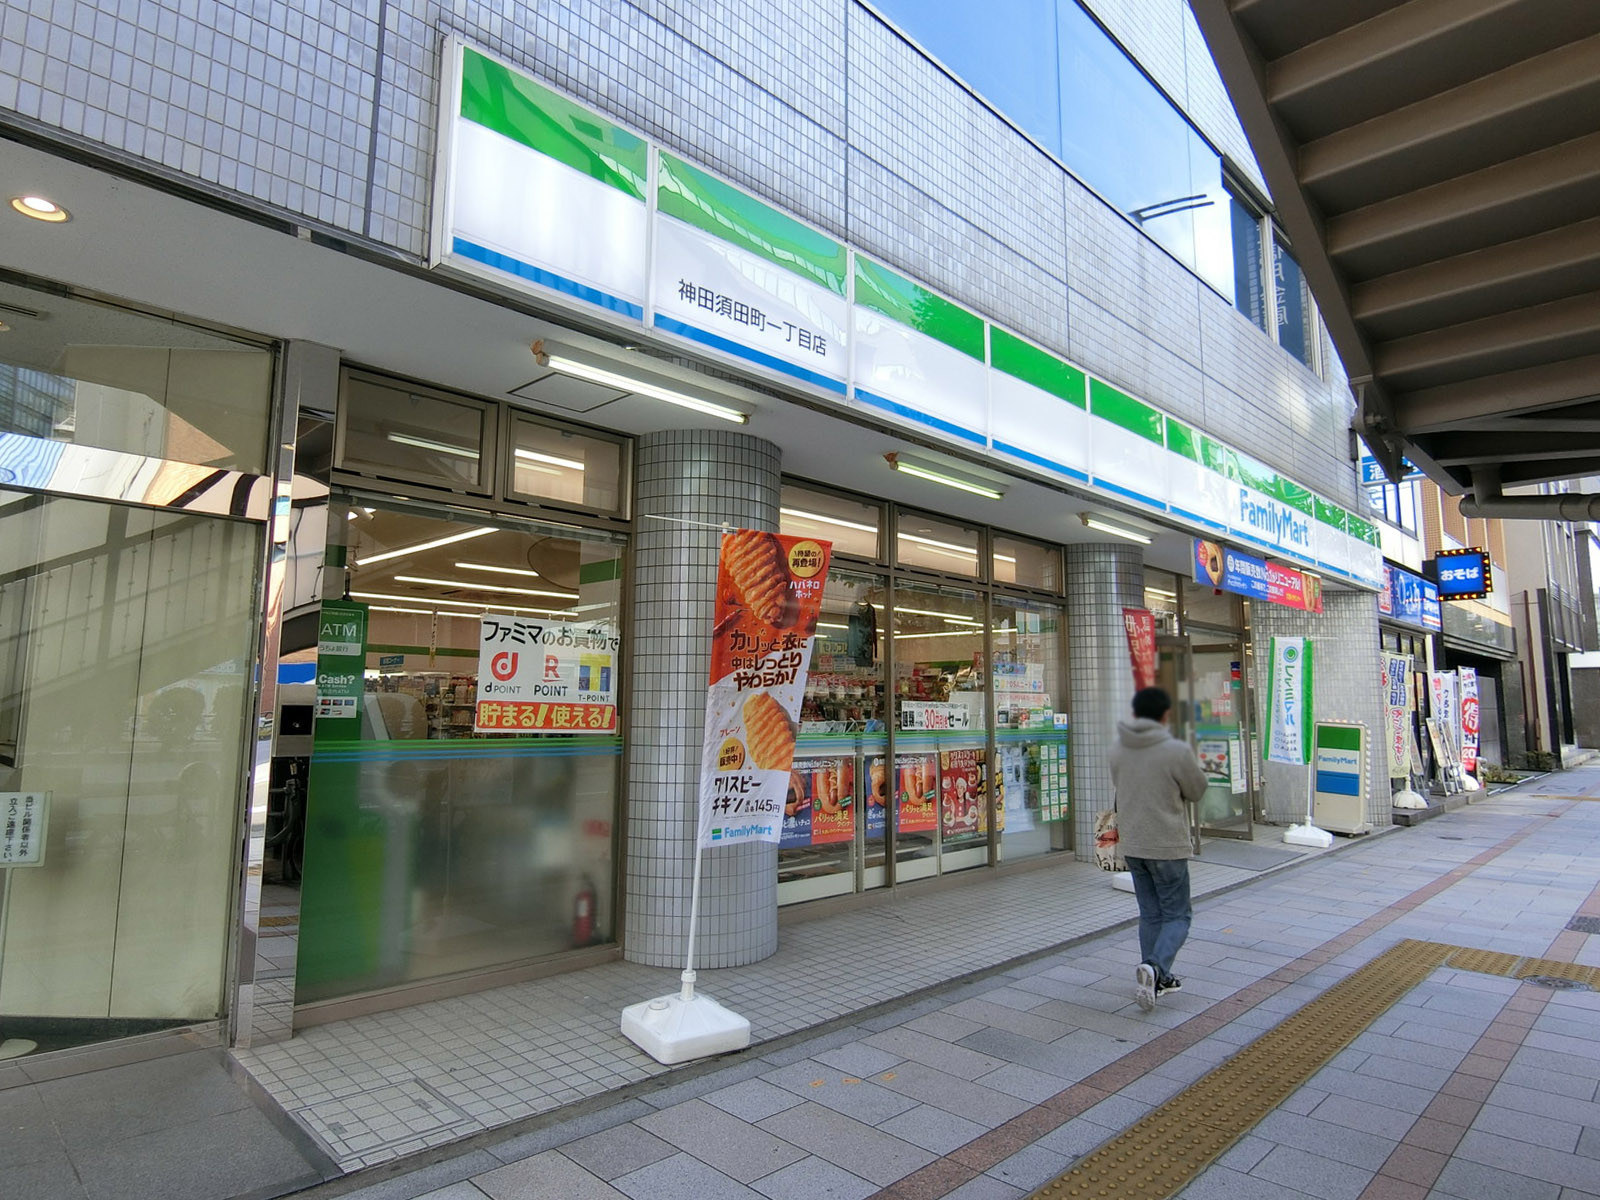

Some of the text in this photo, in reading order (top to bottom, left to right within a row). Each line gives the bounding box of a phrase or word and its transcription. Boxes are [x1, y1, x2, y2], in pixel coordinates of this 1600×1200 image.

[678, 278, 827, 357] 神田須田町一丁目店
[1240, 488, 1309, 547] FamilyMart
[792, 557, 821, 568] 再登場!
[1440, 566, 1479, 581] おそば
[789, 580, 820, 590] ハバネロ
[795, 589, 812, 598] ホット
[321, 623, 357, 637] ATM
[482, 620, 619, 651] ファミマのお買物で
[730, 628, 808, 653] カリッと衣に
[731, 651, 803, 671] 中はしっとり
[319, 674, 355, 685] Cash?
[733, 668, 797, 691] やわらか!
[494, 685, 522, 694] POINT
[534, 685, 568, 697] POINT
[578, 694, 610, 702] T-POINT
[479, 703, 613, 728] 貯まる! 使える!
[720, 726, 741, 738] プレーン
[720, 752, 743, 767] 販売中!
[1319, 754, 1358, 765] FamilyMart
[715, 775, 762, 794] クリスピー
[712, 796, 744, 817] チキン
[19, 795, 34, 857] 当ビル関係者以外
[724, 824, 772, 838] FamilyMart
